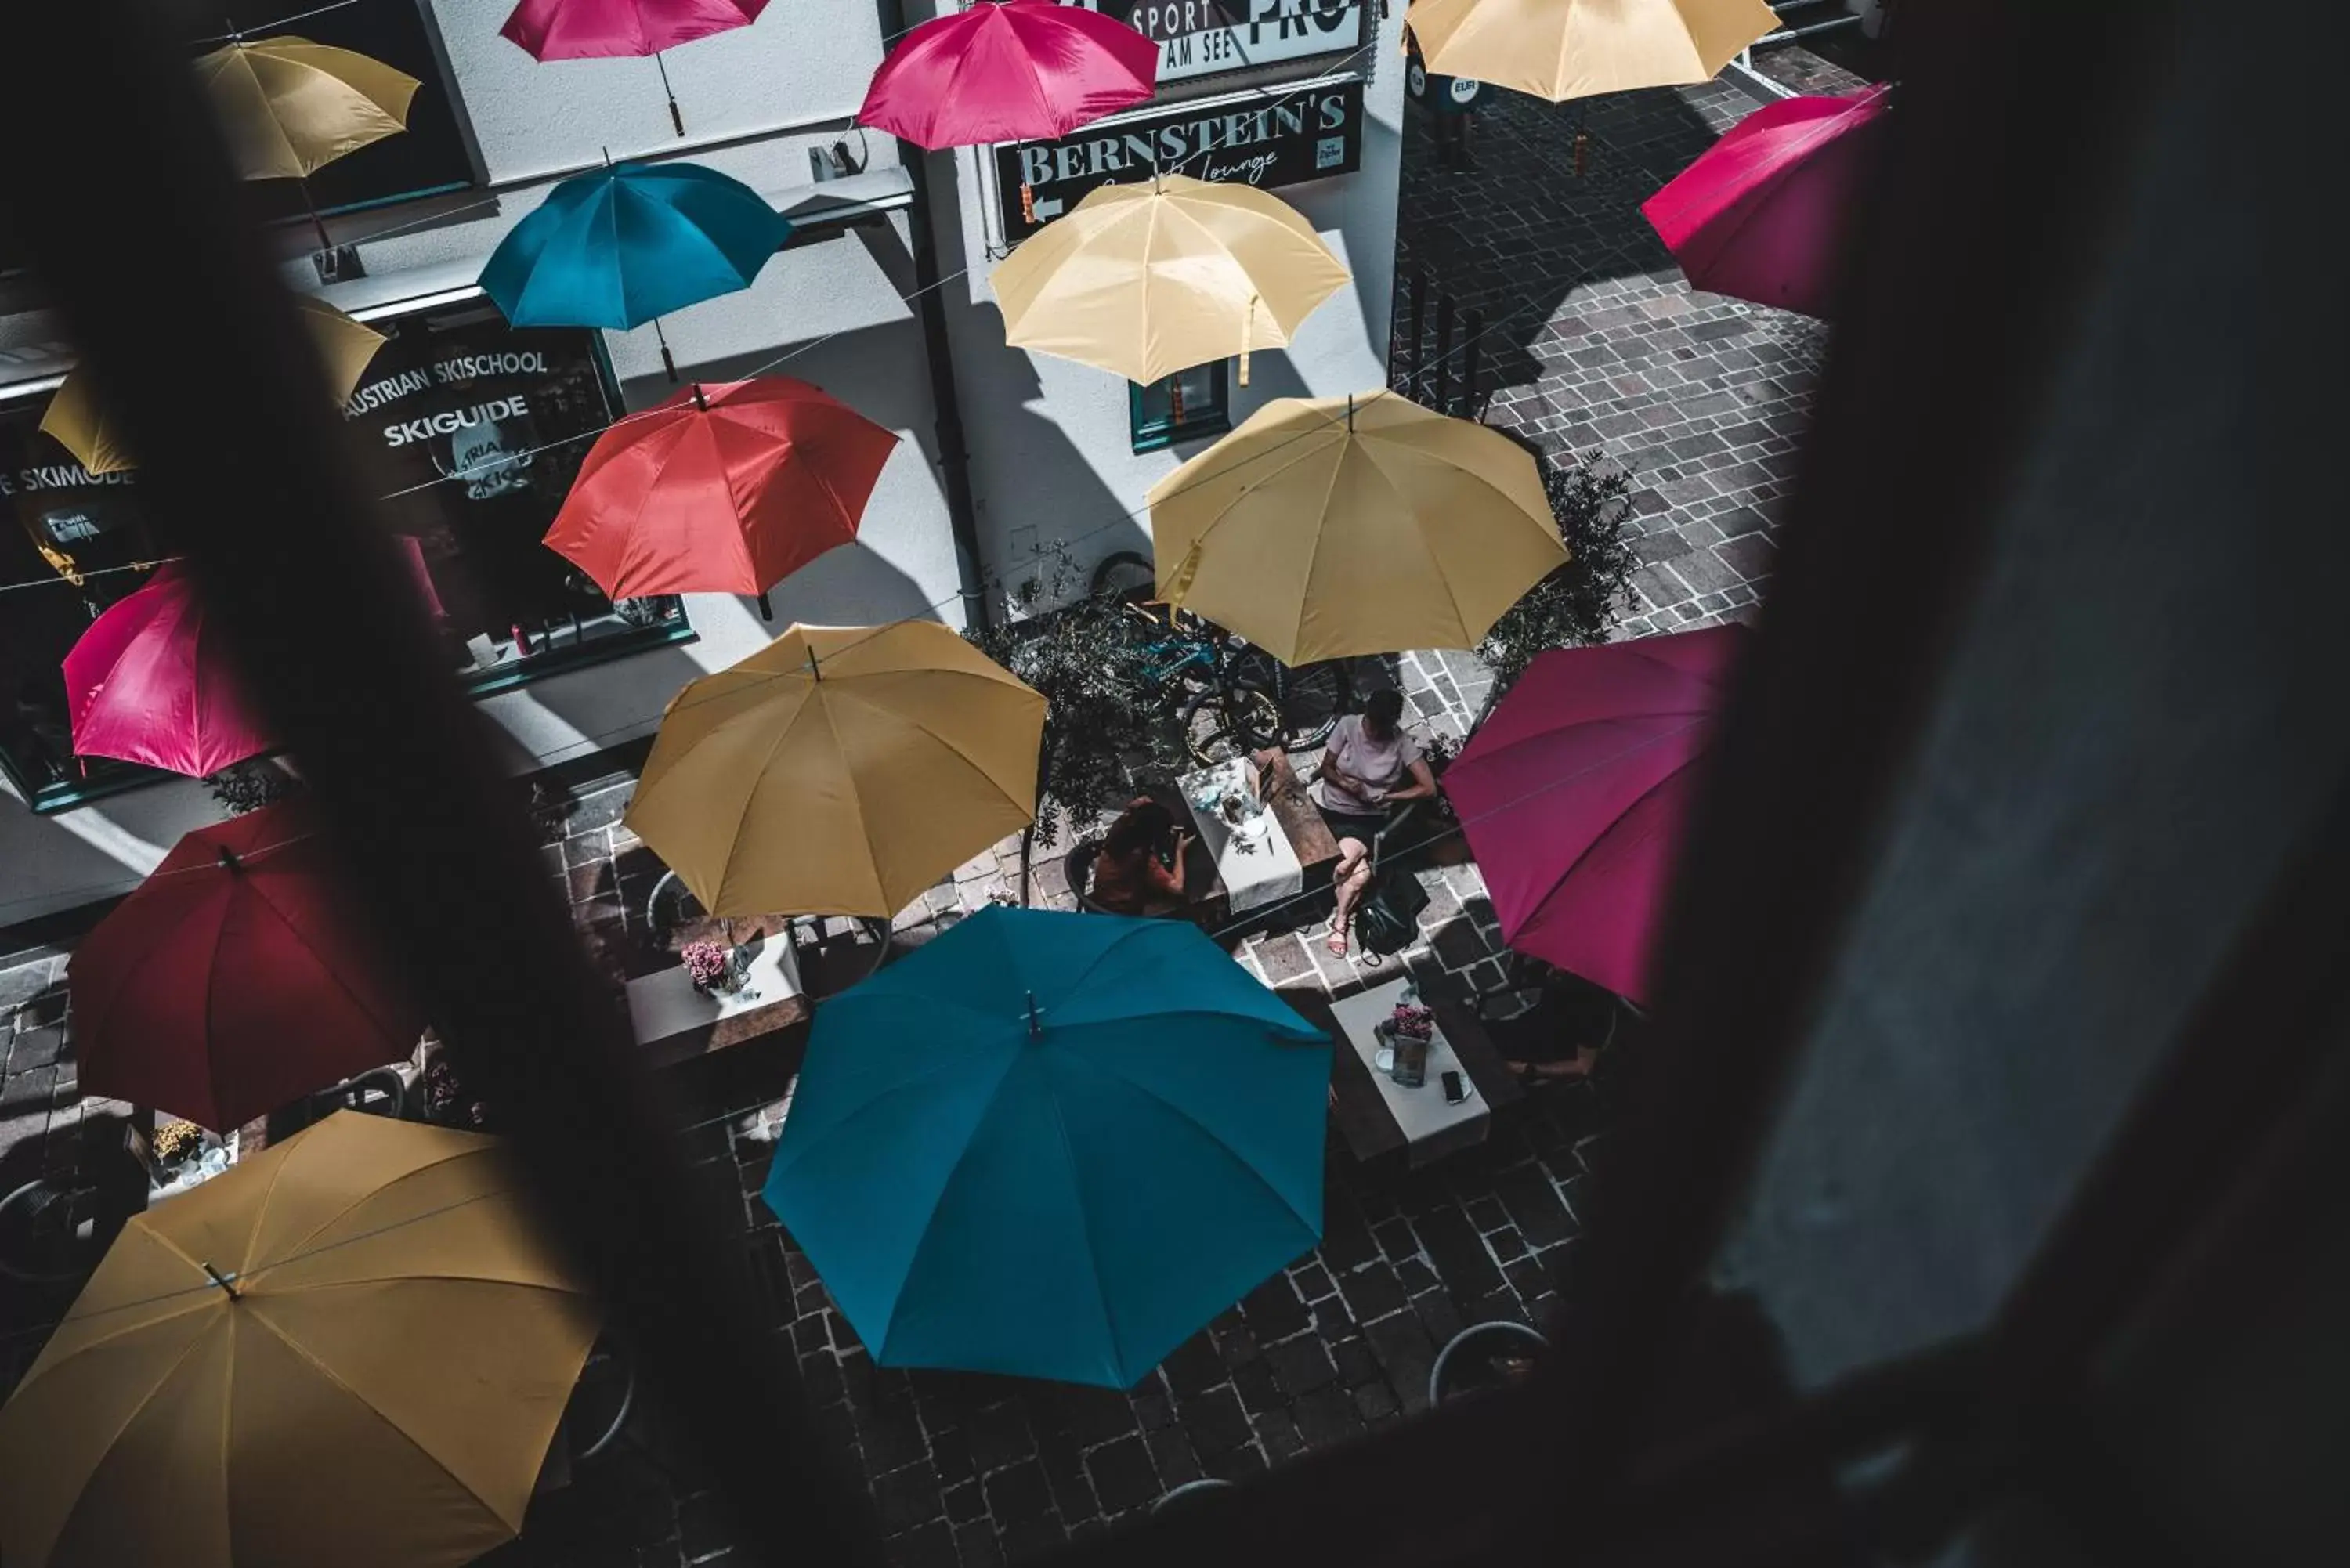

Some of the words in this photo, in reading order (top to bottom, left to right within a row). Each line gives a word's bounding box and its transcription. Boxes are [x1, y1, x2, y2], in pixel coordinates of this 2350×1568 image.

[1133, 0, 1210, 38] SPORT
[1166, 38, 1191, 69] AM
[1203, 28, 1231, 62] SEE
[1021, 94, 1346, 186] BERNSTEIN'S
[434, 352, 548, 383] SKISCHOOL
[384, 396, 529, 446] SKIGUIDE
